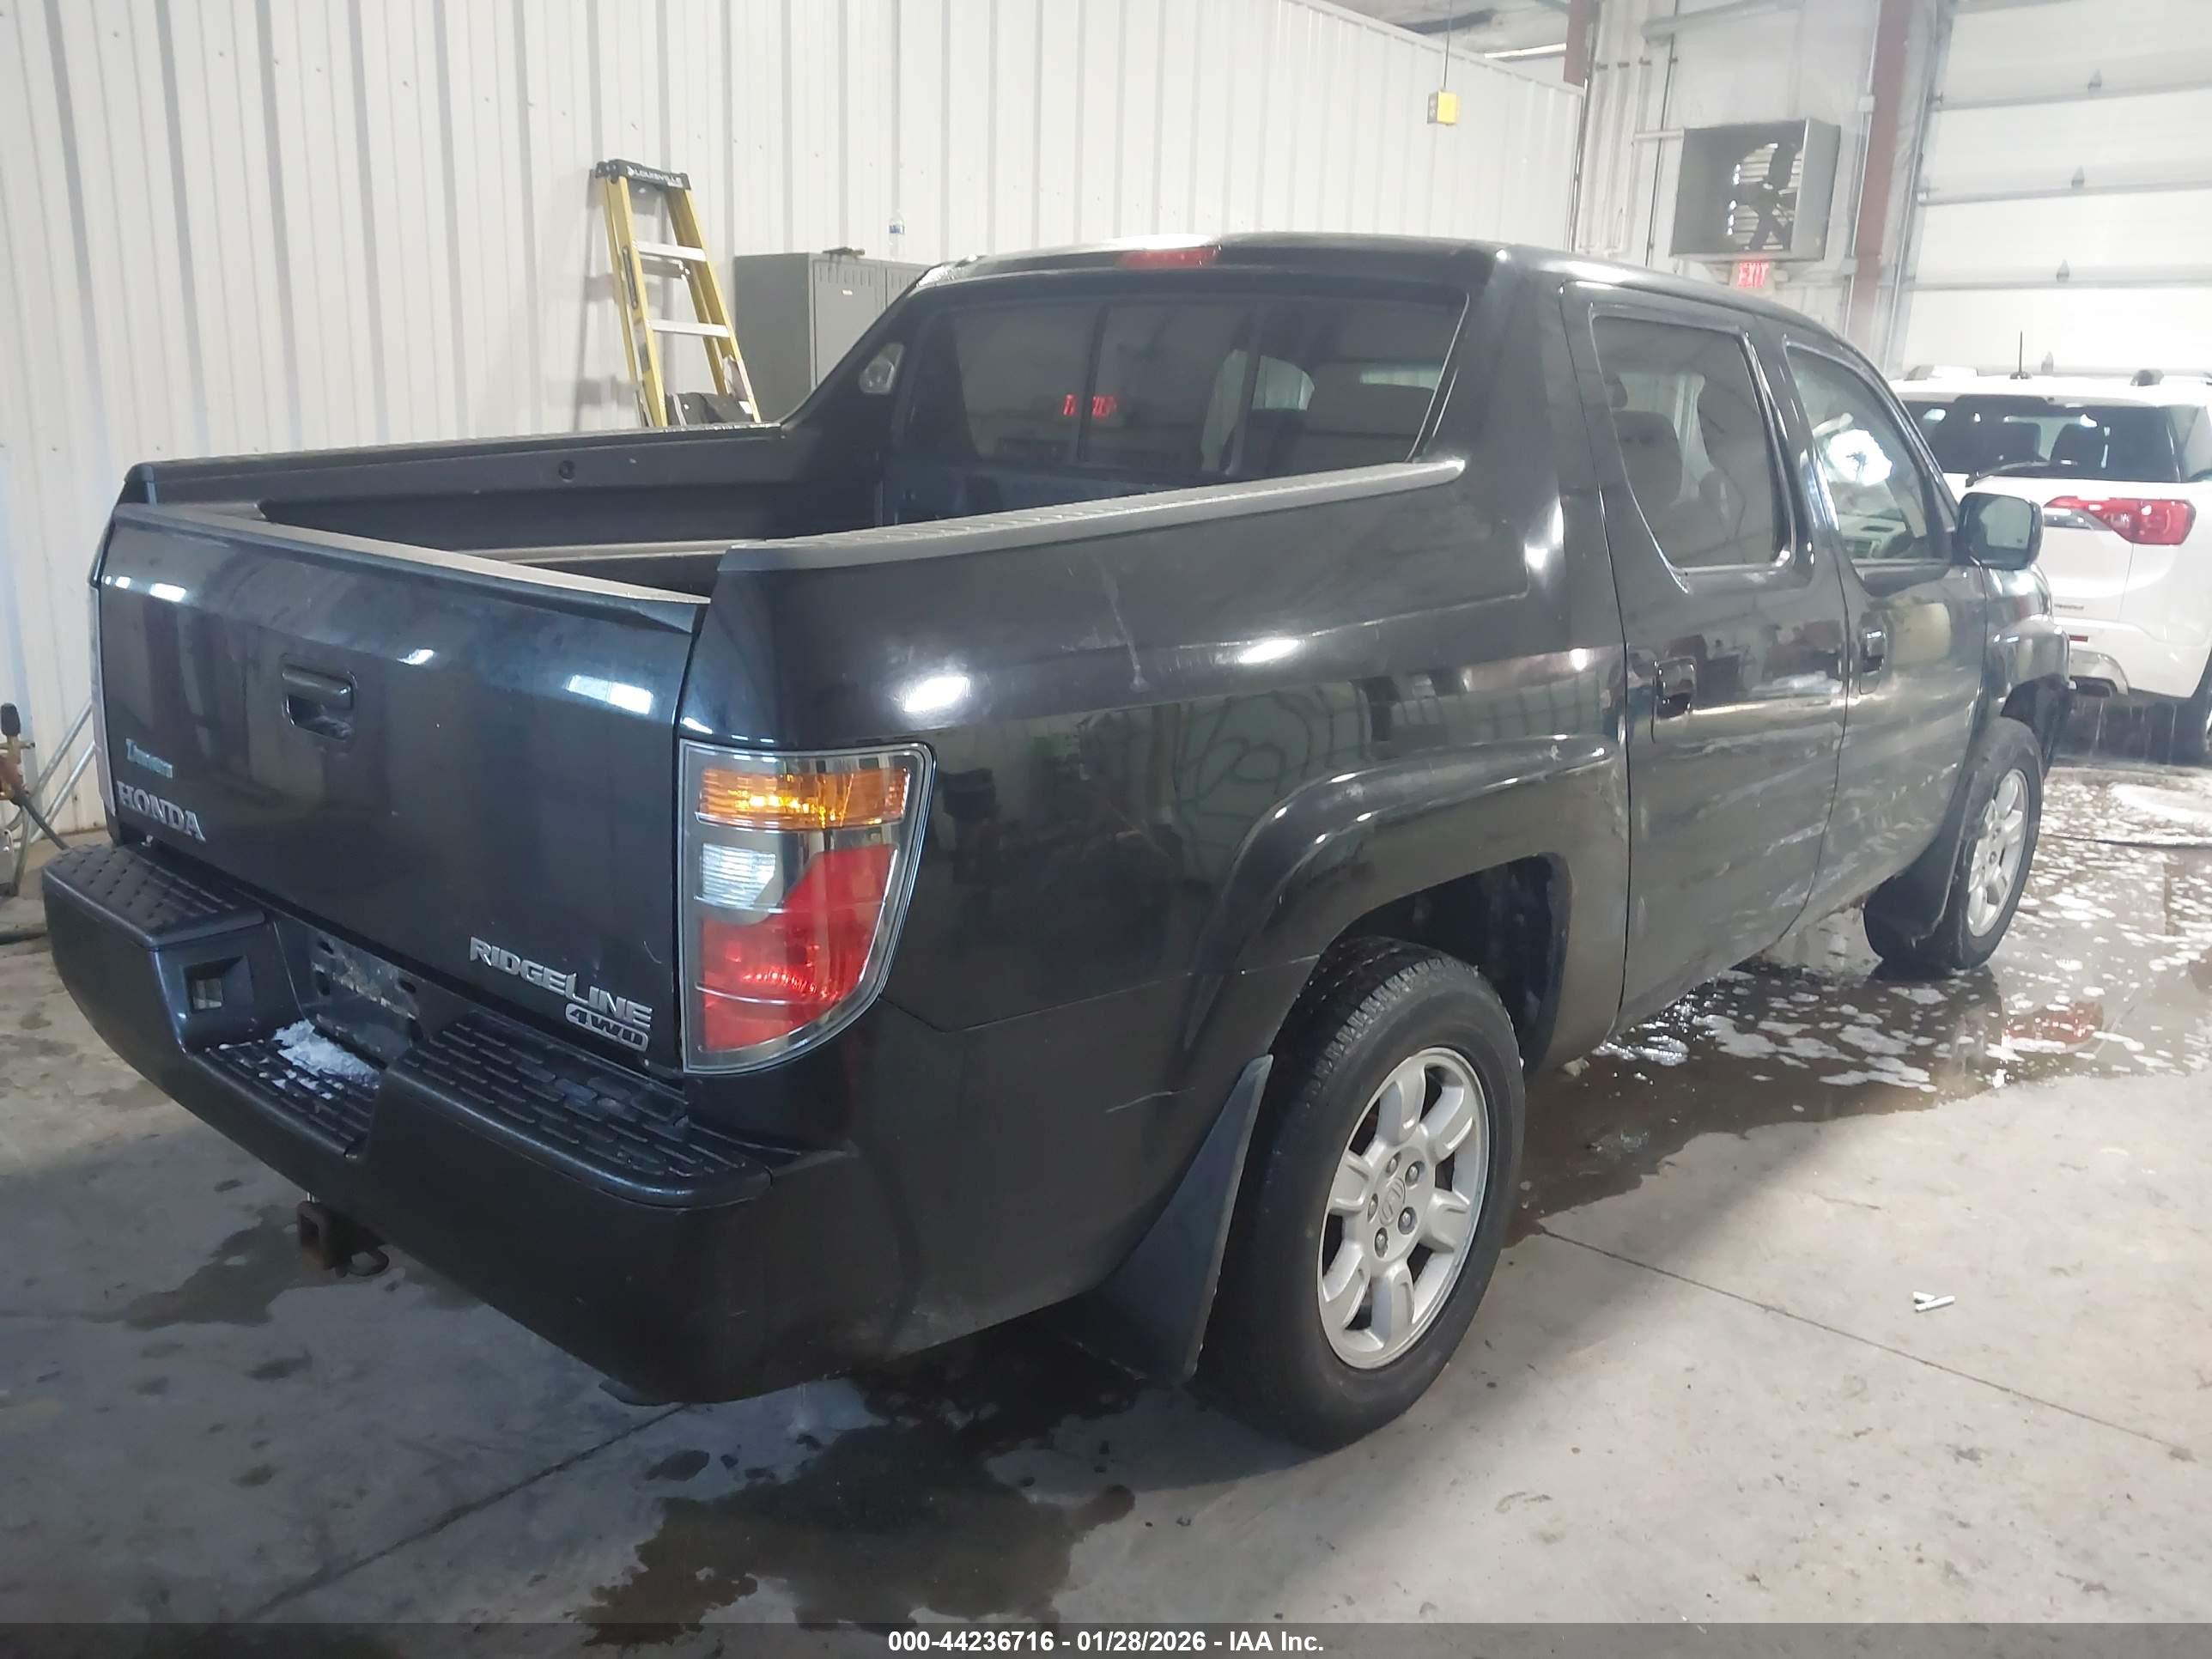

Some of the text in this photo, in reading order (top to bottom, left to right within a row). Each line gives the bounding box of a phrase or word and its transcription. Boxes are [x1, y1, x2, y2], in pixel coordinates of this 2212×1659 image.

[1738, 261, 1769, 288] EXIT
[117, 780, 206, 842] HONDA
[470, 936, 653, 1030] RIDGELINE
[567, 1005, 647, 1049] 4WD
